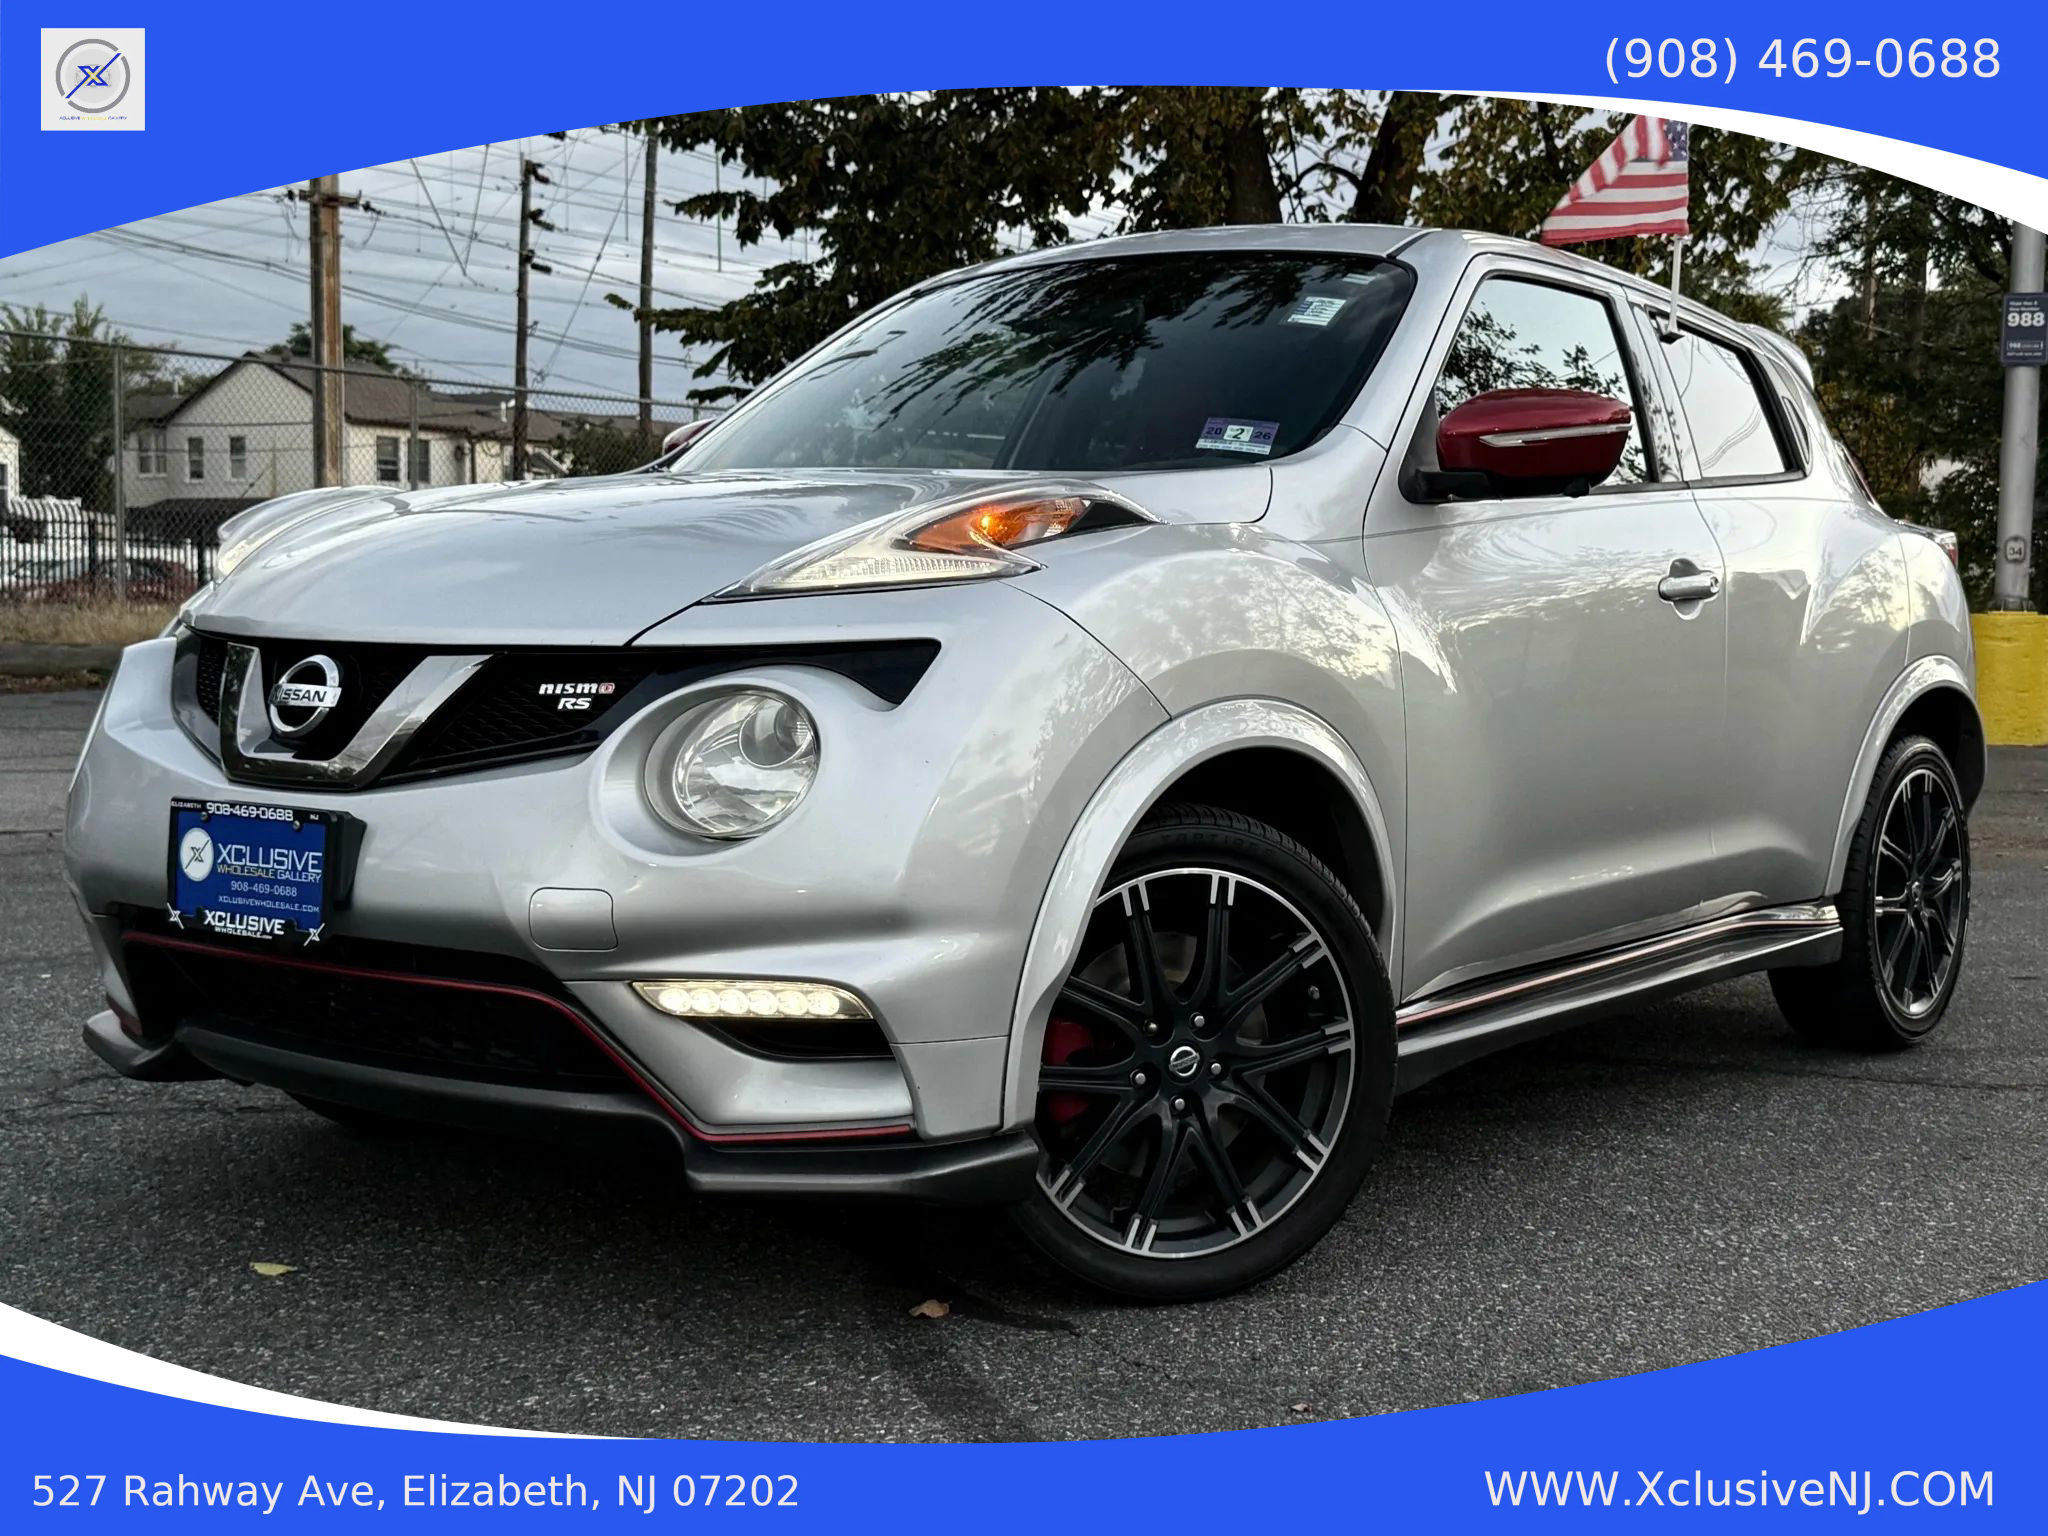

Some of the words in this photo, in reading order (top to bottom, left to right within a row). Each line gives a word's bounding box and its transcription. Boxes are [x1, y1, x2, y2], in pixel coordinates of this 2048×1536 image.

[2007, 312, 2045, 327] 988
[1232, 427, 1246, 440] 2
[557, 697, 592, 710] RS
[205, 802, 294, 821] 908-469-0688
[217, 843, 323, 873] XCLUSIVE
[216, 863, 276, 879] WHOLESALE
[276, 869, 322, 884] GALLERY
[230, 880, 298, 897] 908-469-0688
[218, 895, 320, 913] XCLUSIVEWHOLESALE.COM
[204, 909, 286, 935] XCLUSIVE
